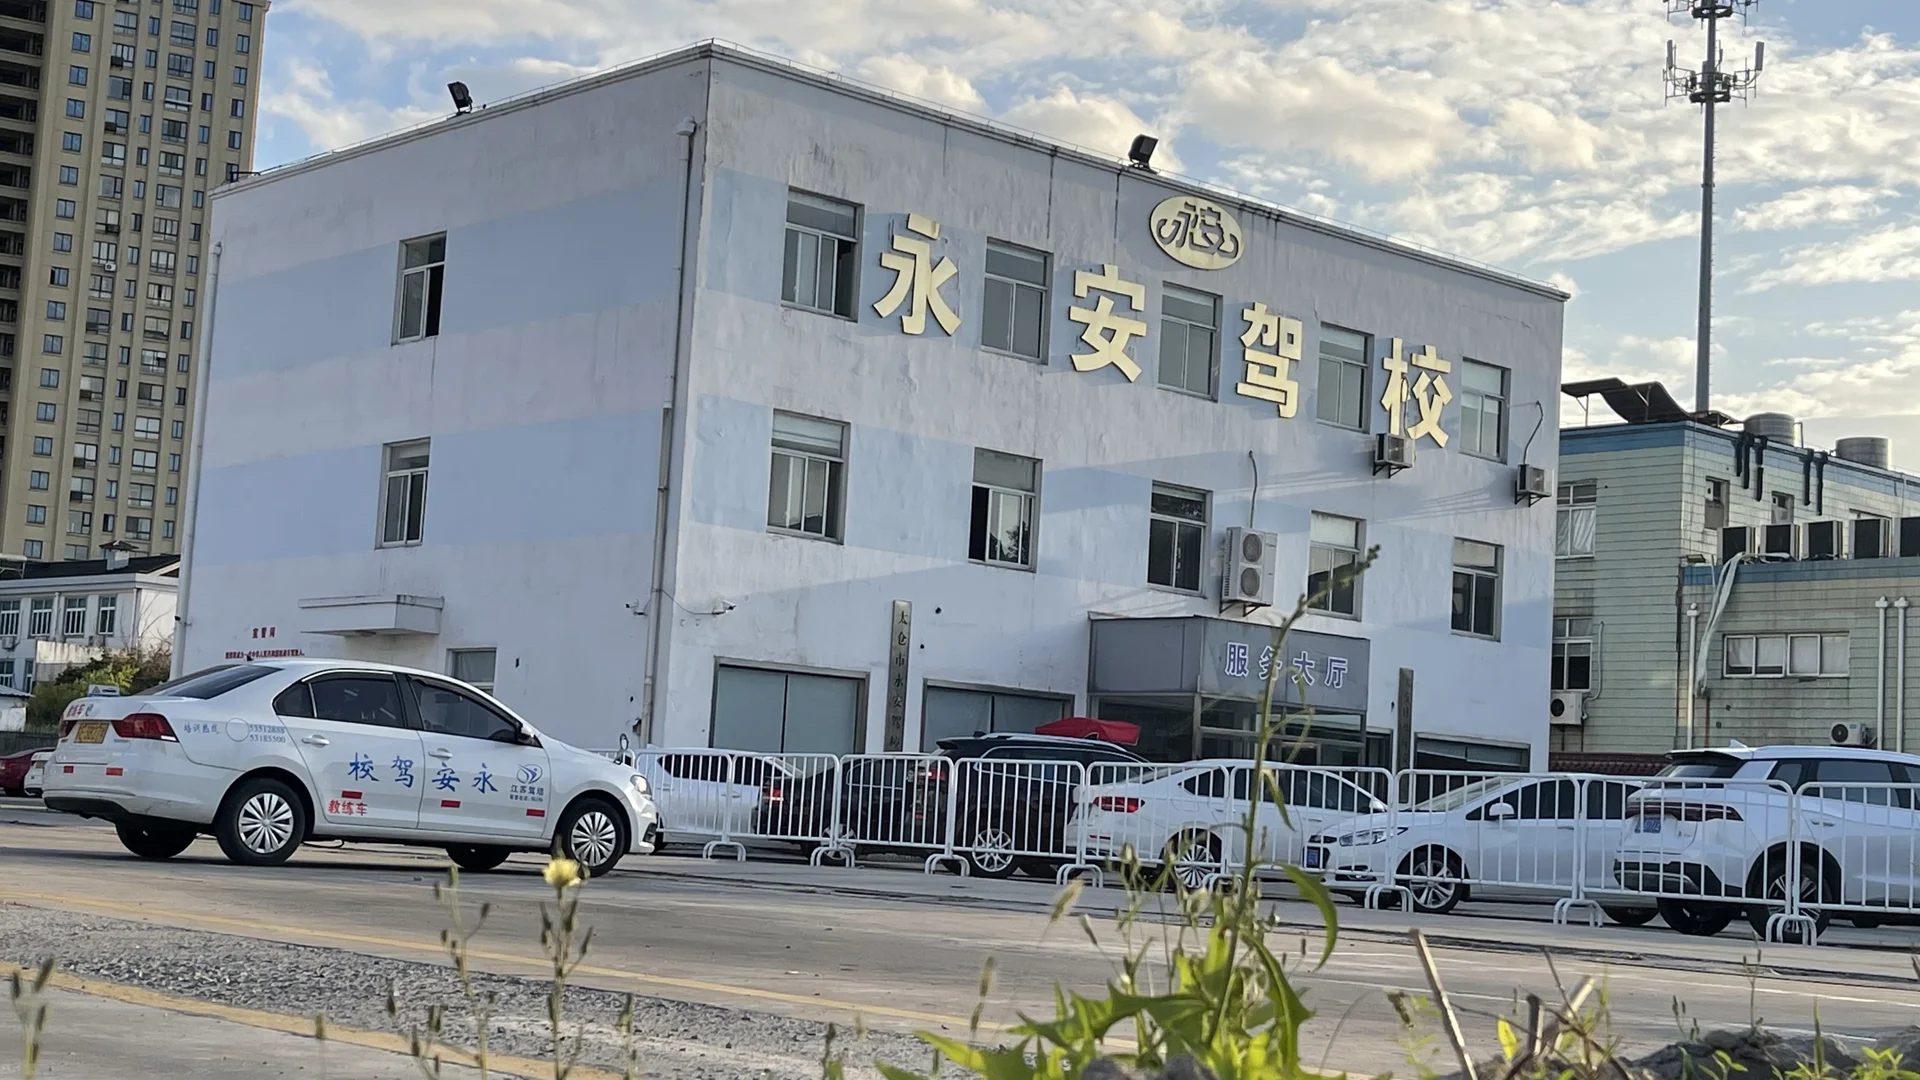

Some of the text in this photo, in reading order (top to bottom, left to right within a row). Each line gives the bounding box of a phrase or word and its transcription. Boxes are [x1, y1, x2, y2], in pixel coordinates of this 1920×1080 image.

[873, 213, 1453, 448] 永安驾校
[1225, 642, 1348, 688] 服务大厅
[328, 800, 368, 816] 教练车
